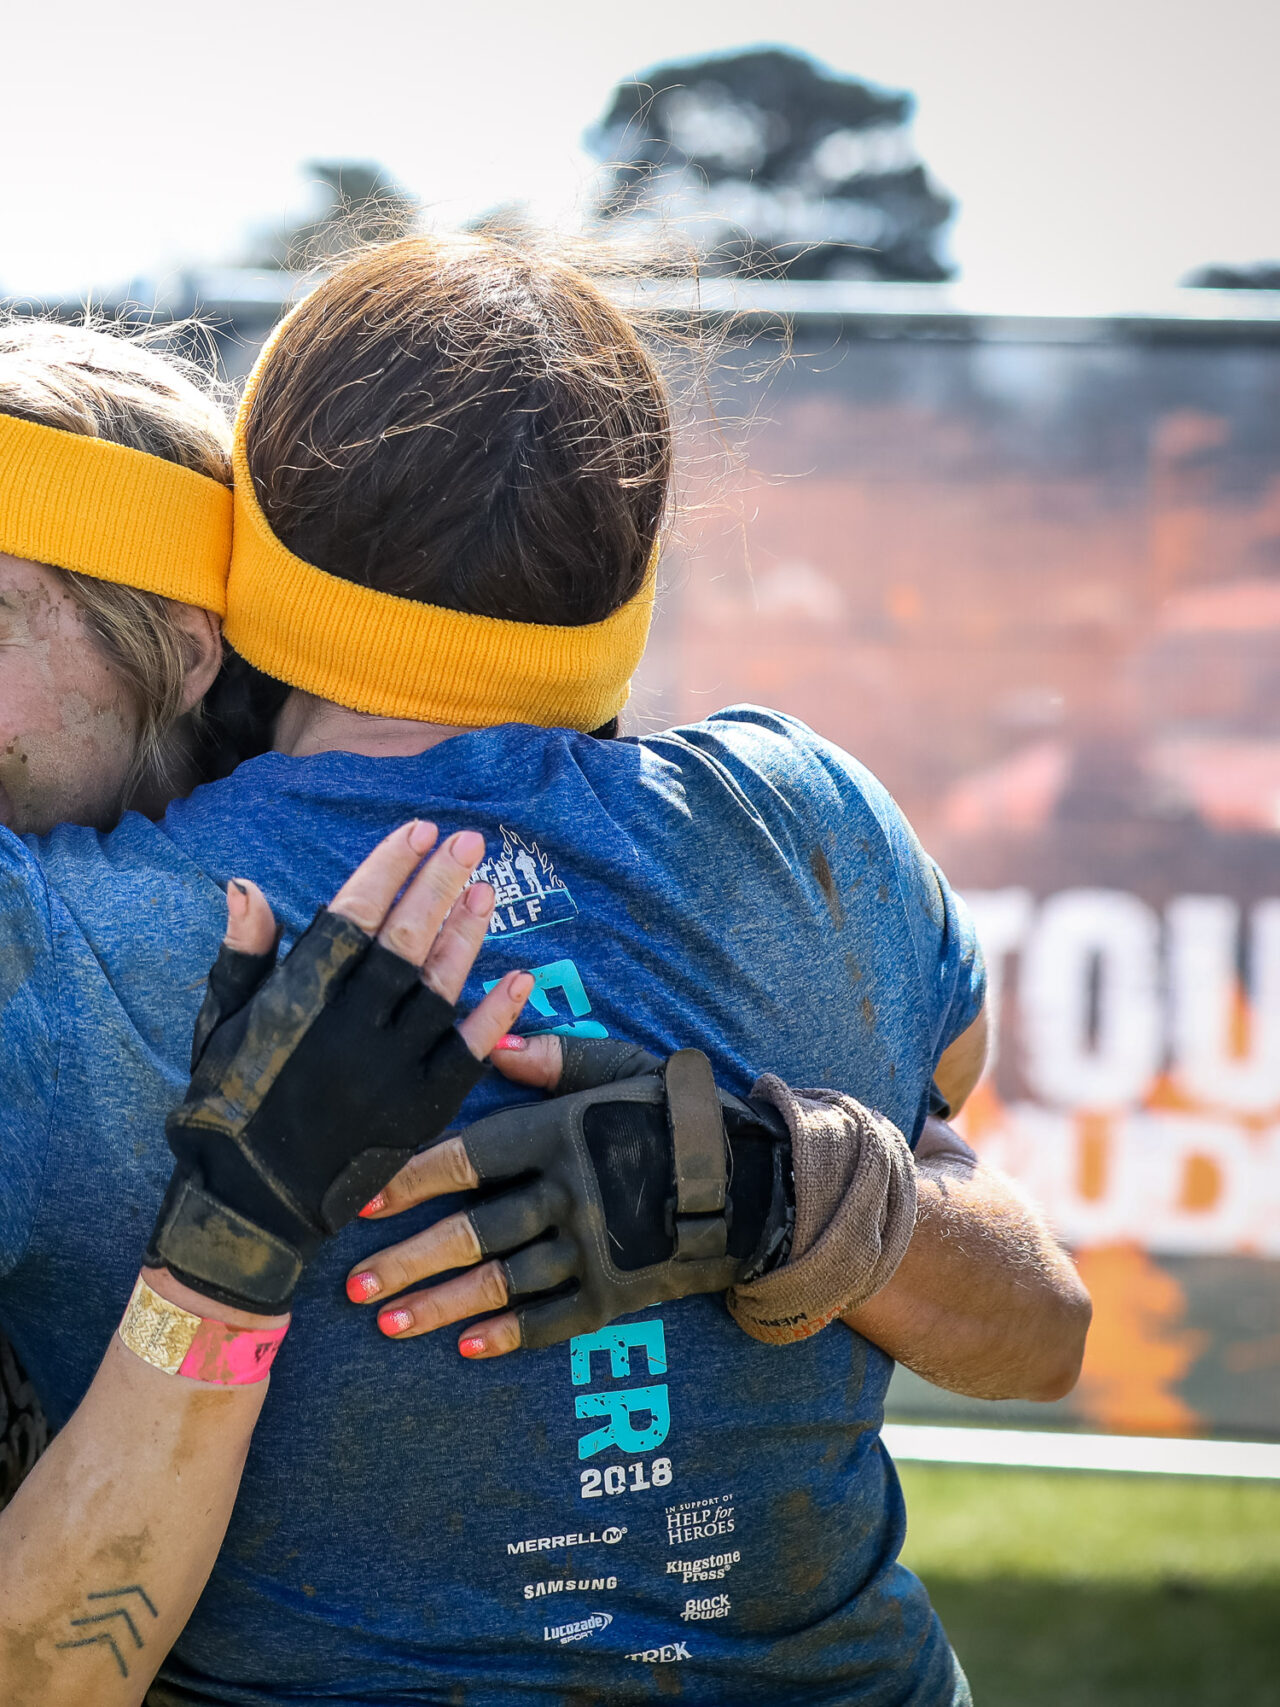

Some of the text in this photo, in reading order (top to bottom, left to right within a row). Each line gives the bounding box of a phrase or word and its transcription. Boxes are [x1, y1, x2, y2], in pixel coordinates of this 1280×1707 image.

[489, 898, 542, 934] ALF
[580, 1457, 673, 1499] 2018
[665, 1506, 676, 1514] IN
[679, 1497, 720, 1511] SUPPORT
[666, 1505, 735, 1530] HELP for
[507, 1531, 601, 1555] MERRELL
[667, 1518, 735, 1546] HEROES
[666, 1550, 741, 1574] Kingstone
[523, 1576, 618, 1600] SAMSUNG
[680, 1605, 732, 1622] Tower
[685, 1593, 731, 1613] Black
[543, 1615, 604, 1641] Lucozade
[560, 1630, 594, 1645] SPORT
[624, 1640, 694, 1663] TREK
